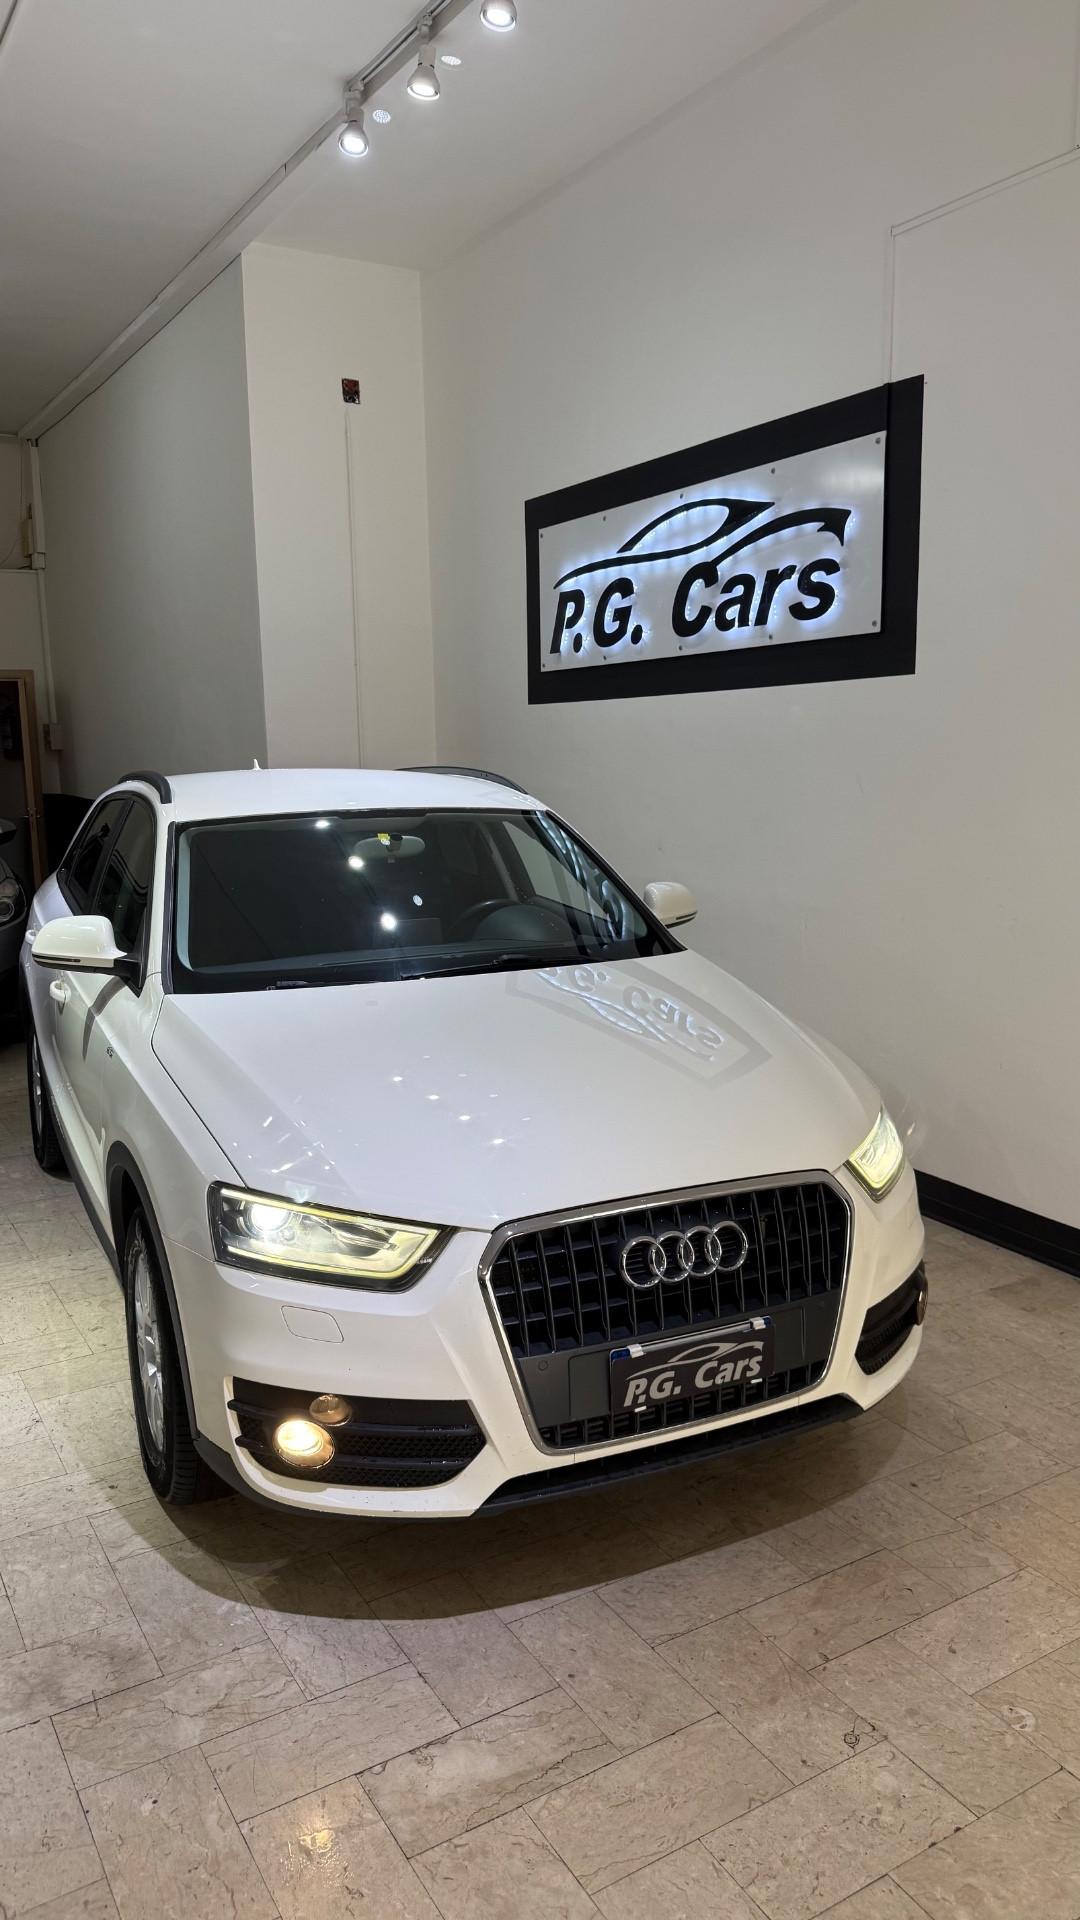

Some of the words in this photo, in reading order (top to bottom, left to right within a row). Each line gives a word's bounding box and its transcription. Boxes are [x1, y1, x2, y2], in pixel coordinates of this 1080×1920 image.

[549, 577, 643, 654] P.G.
[671, 558, 841, 638] Cars
[623, 1370, 682, 1407] P.G.
[694, 1354, 763, 1389] Cars
